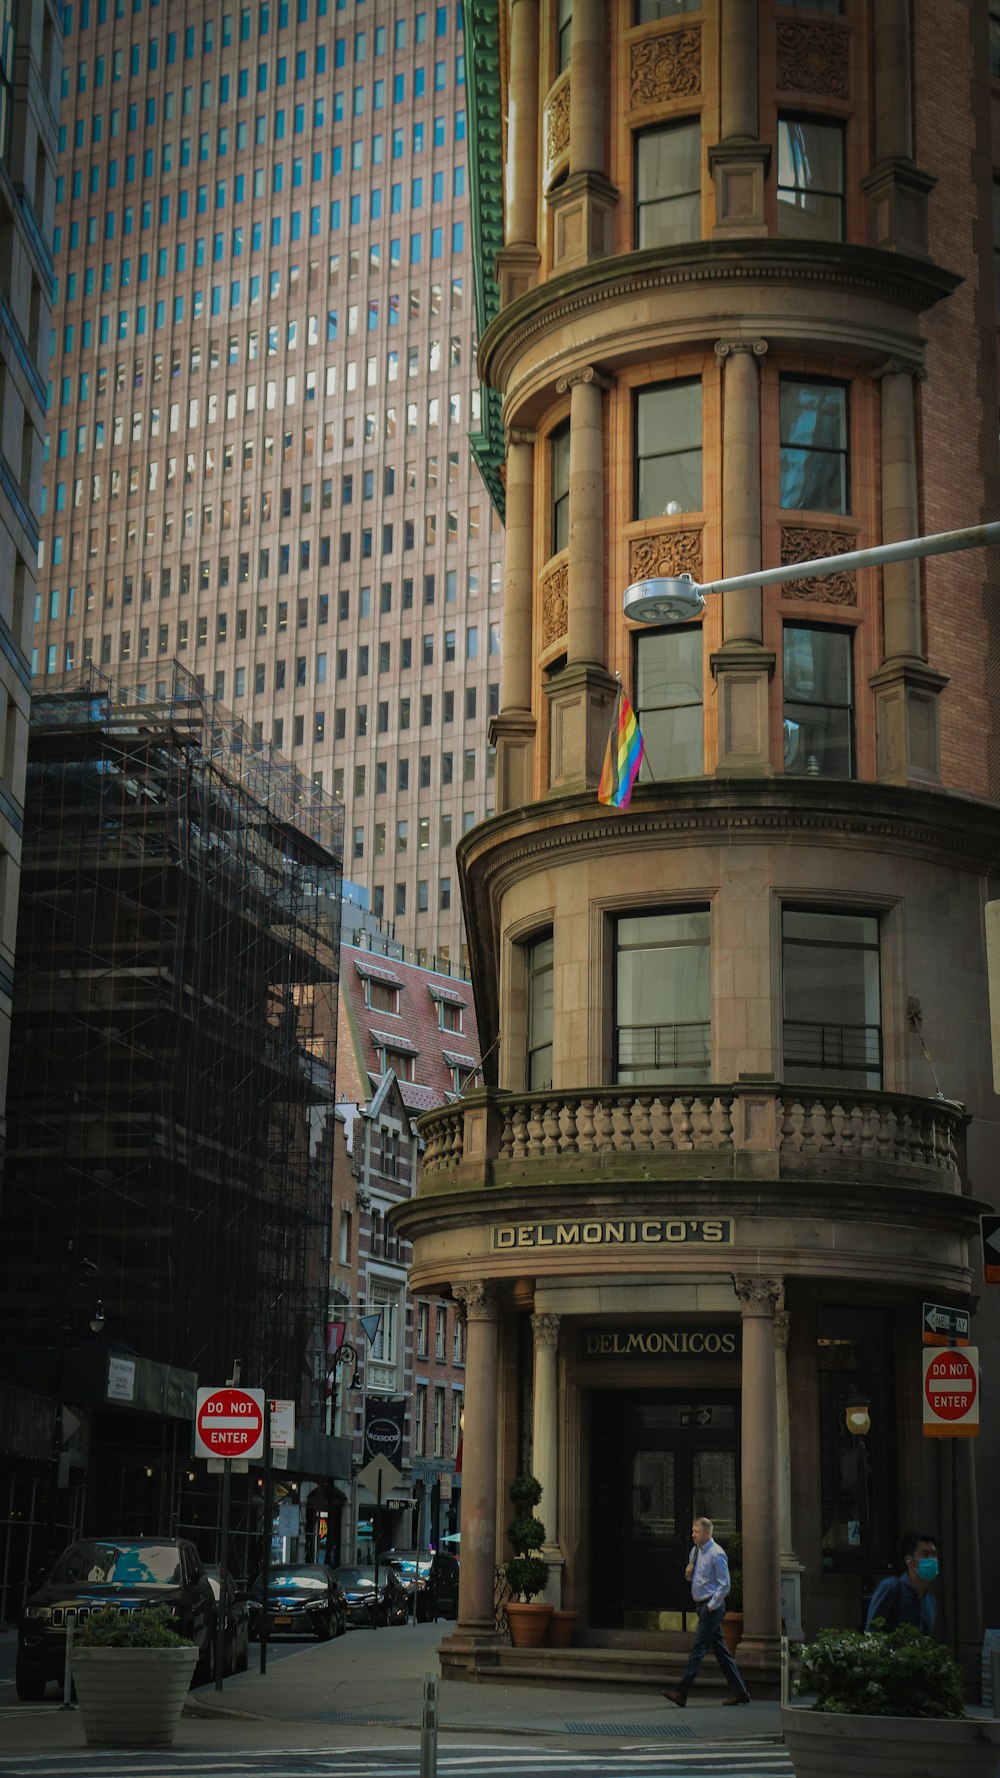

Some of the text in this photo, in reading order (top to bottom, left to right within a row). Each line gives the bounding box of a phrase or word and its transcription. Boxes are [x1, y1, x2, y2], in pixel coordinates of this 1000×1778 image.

[497, 1220, 723, 1248] DELMONICO'S
[931, 1313, 945, 1327] ONE
[586, 1333, 737, 1354] DELMONICOS
[932, 1363, 969, 1376] DO NOT
[207, 1402, 254, 1414] DO NOT
[933, 1395, 968, 1408] ENTER
[210, 1432, 248, 1444] ENTER
